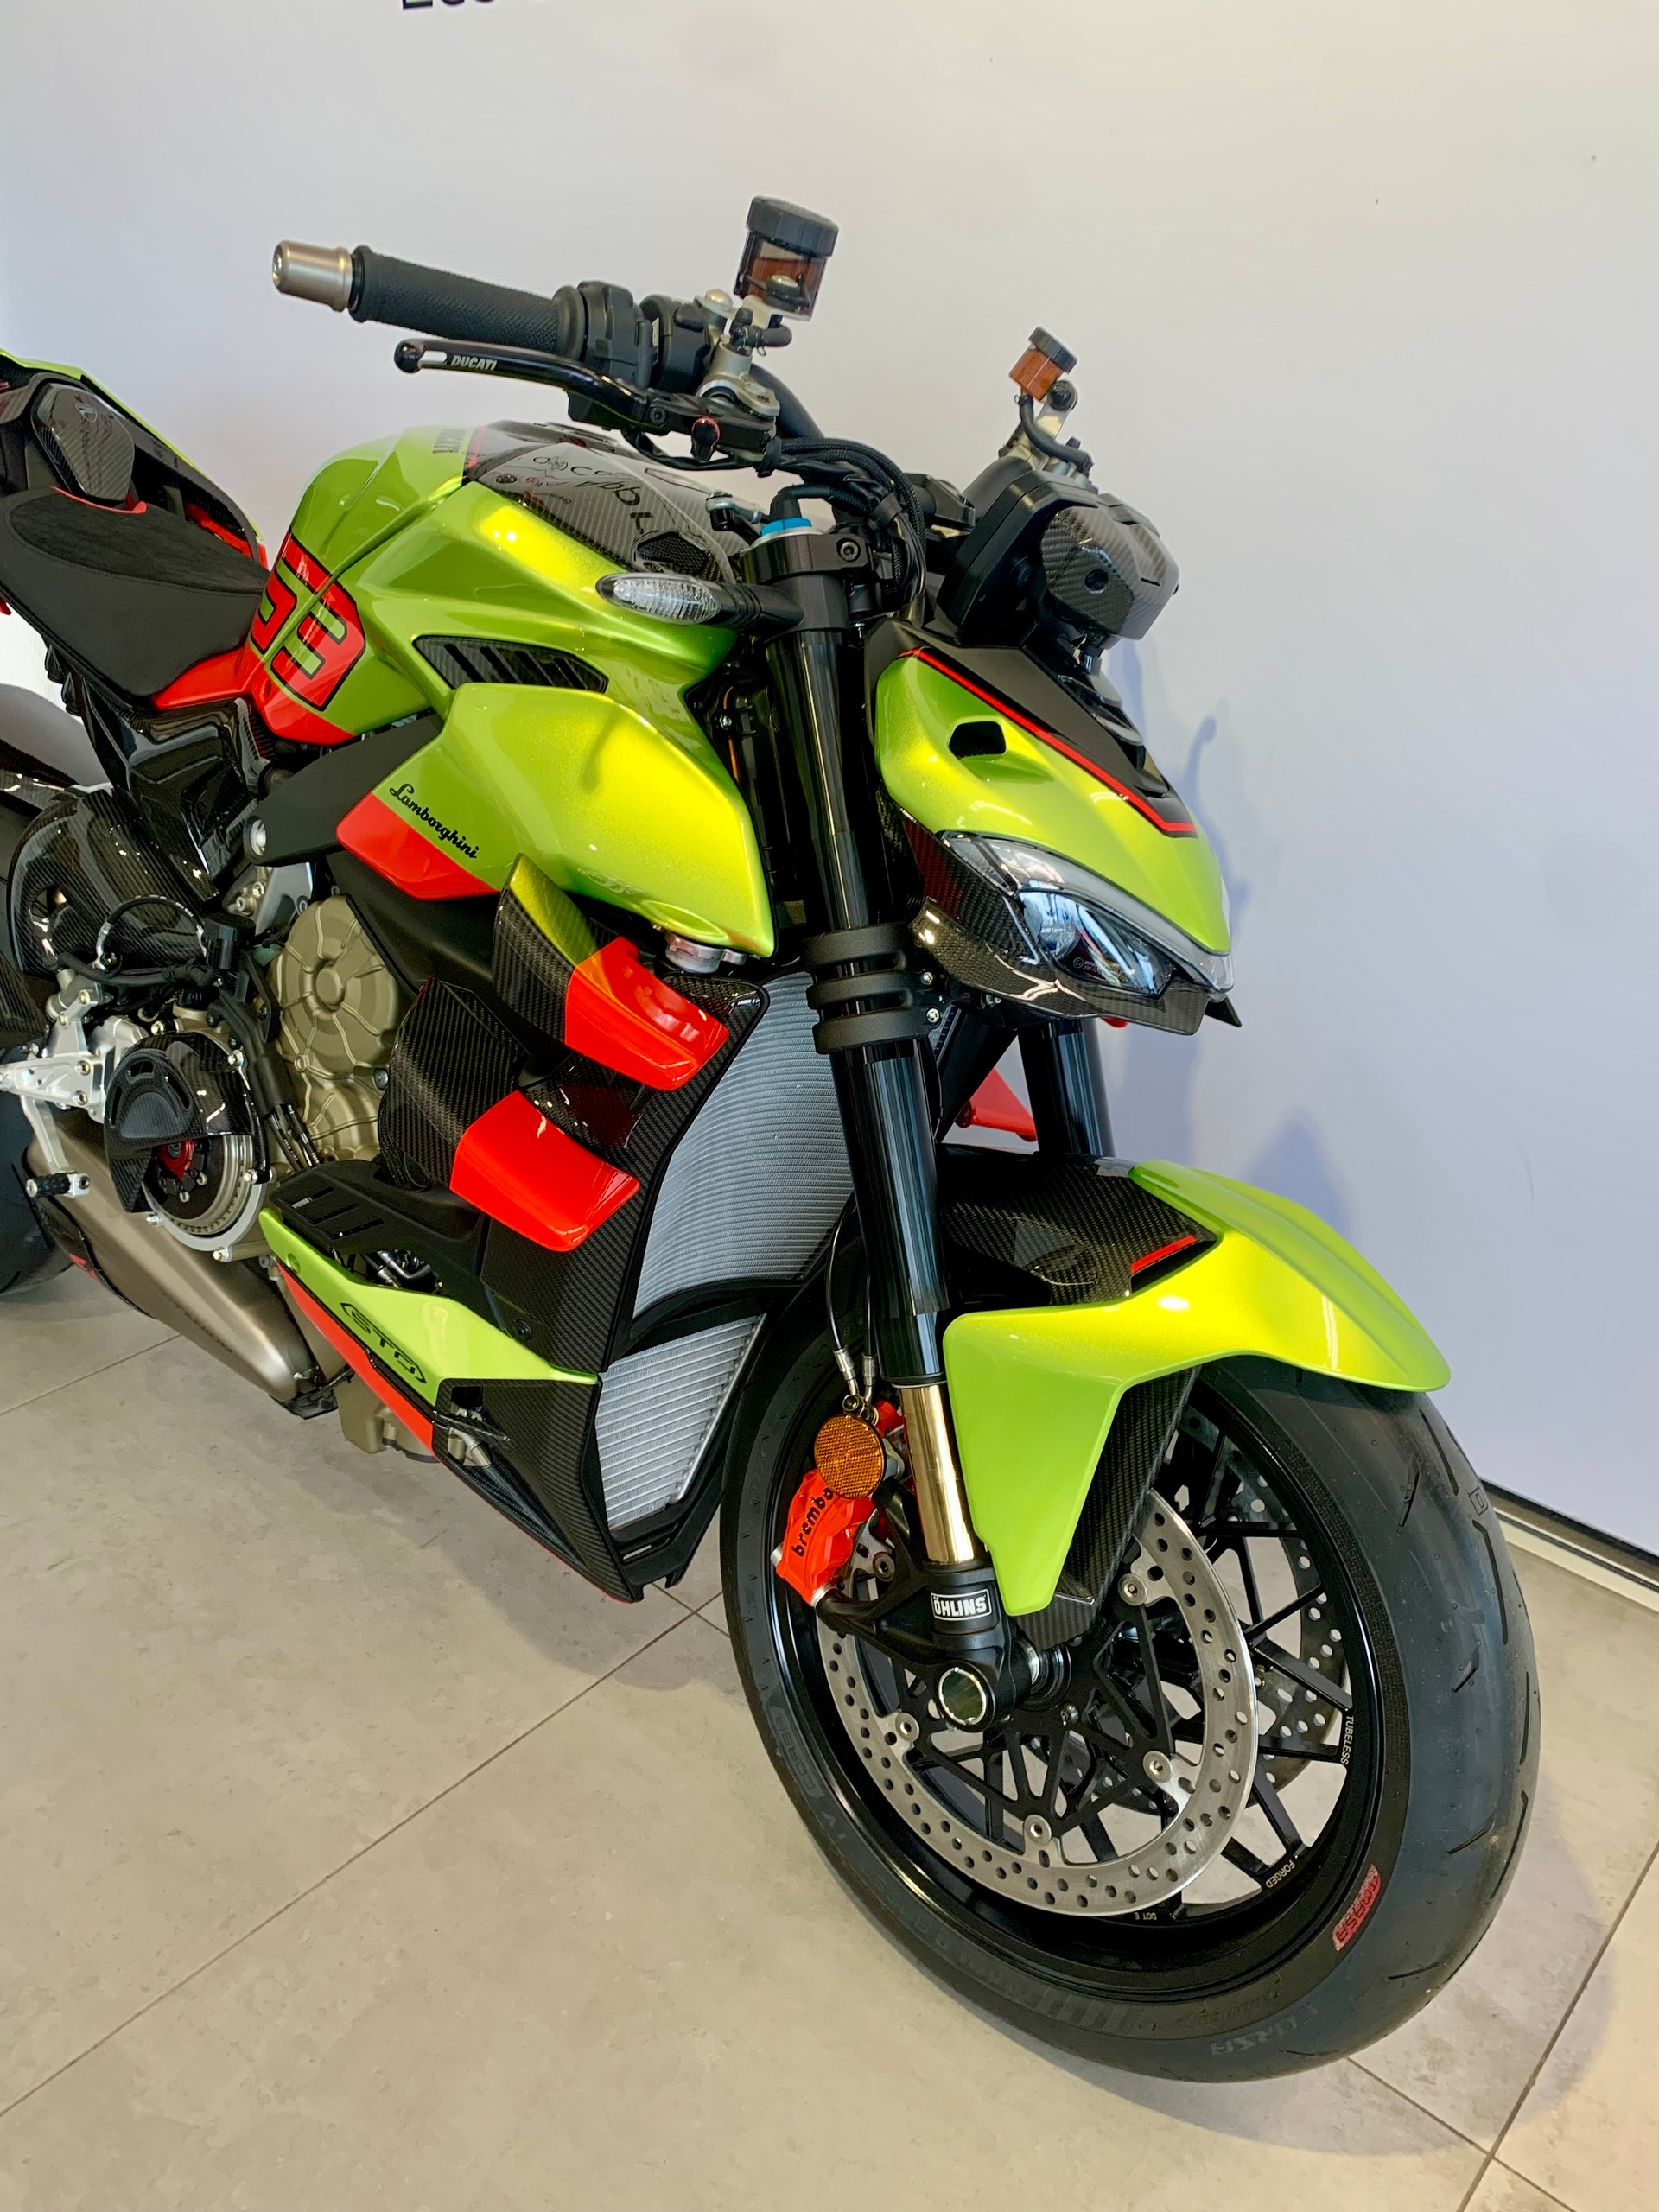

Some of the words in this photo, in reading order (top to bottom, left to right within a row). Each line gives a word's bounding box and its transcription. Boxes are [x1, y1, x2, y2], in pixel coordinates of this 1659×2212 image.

[450, 355, 498, 372] DUCATI
[389, 783, 480, 859] Lamborghini
[350, 1309, 416, 1375] STO
[791, 1487, 834, 1557] brembo
[933, 1595, 987, 1617] ÖHLINS
[1340, 1715, 1355, 1765] TUBELESS
[1265, 1859, 1296, 1889] FORGED
[1142, 1911, 1157, 1921] DOT
